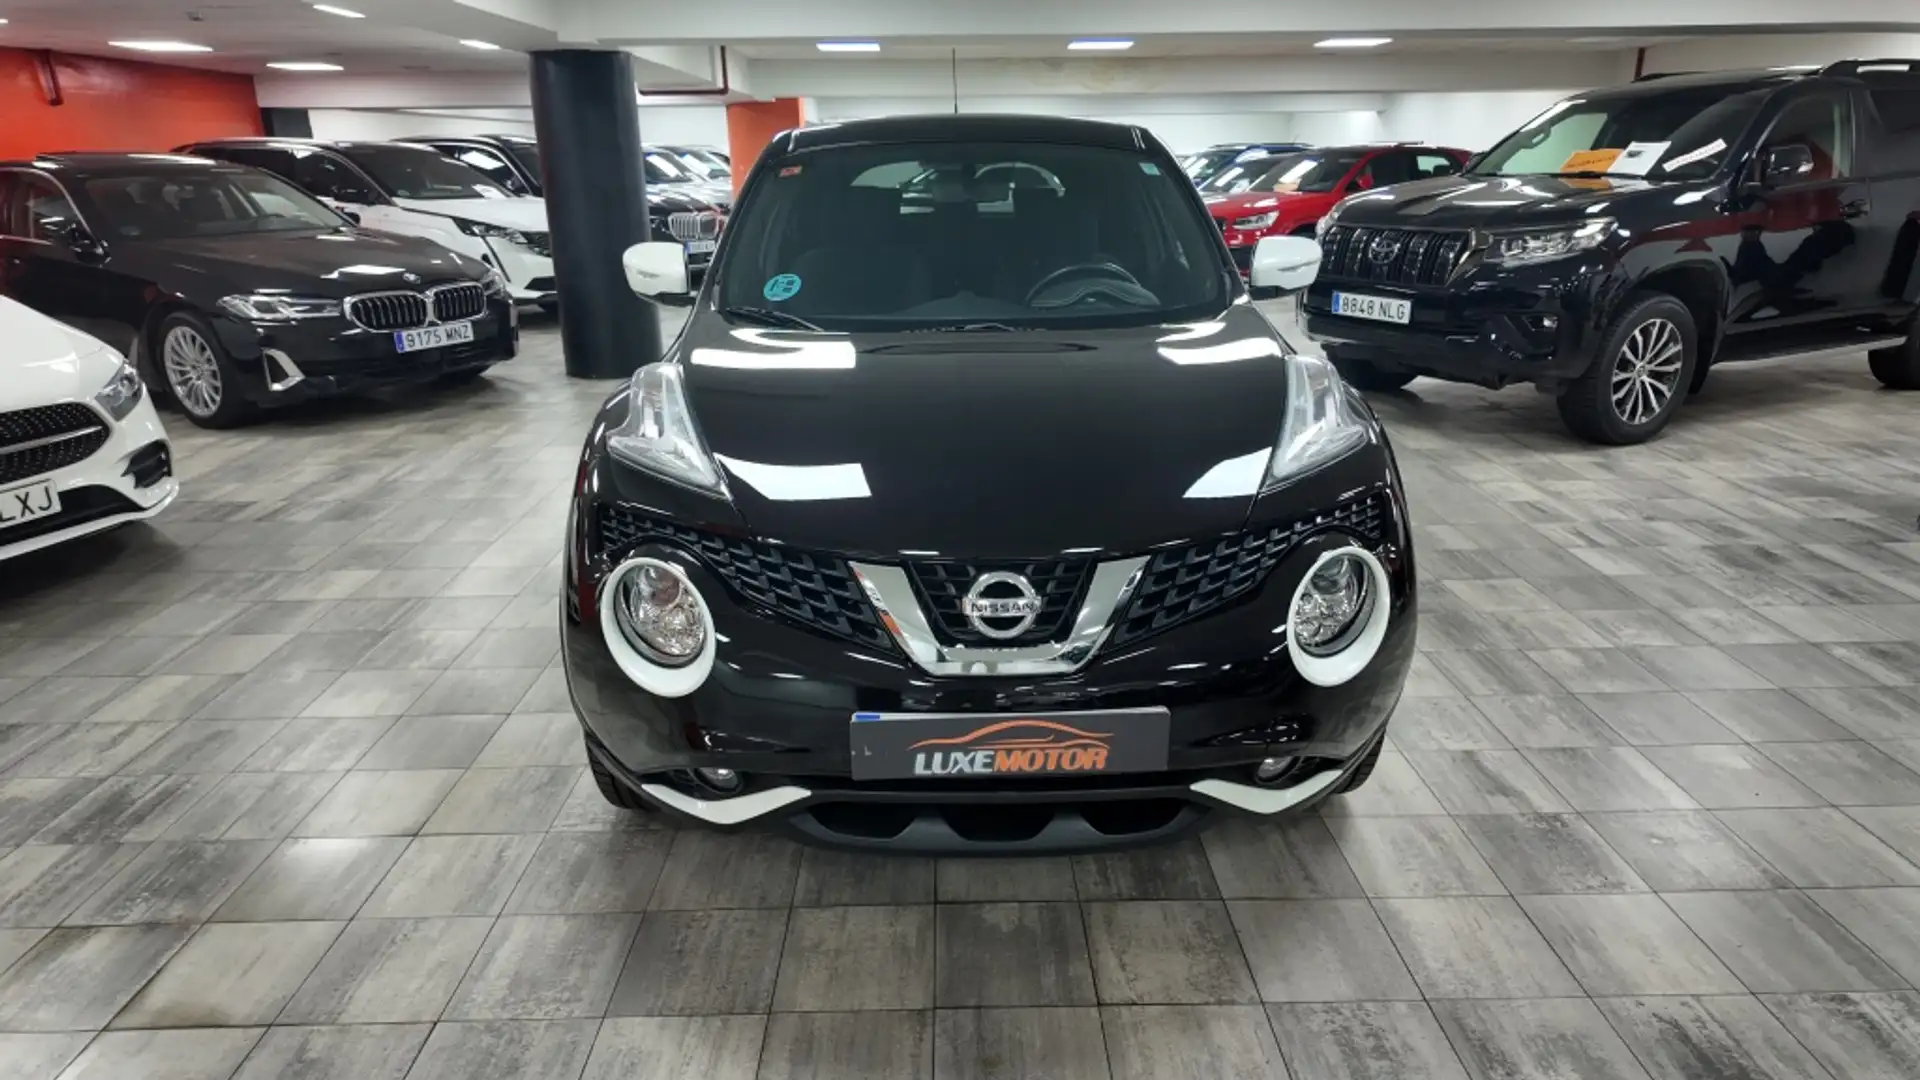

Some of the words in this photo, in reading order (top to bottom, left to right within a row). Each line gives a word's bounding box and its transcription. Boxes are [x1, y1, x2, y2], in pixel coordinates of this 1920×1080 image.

[1342, 296, 1375, 316] 8848
[1378, 300, 1406, 320] NLG
[405, 327, 442, 348] 9175
[444, 323, 471, 342] MNZ
[970, 602, 1036, 613] NISSAN
[914, 748, 1111, 775] LUXEMOTOR
